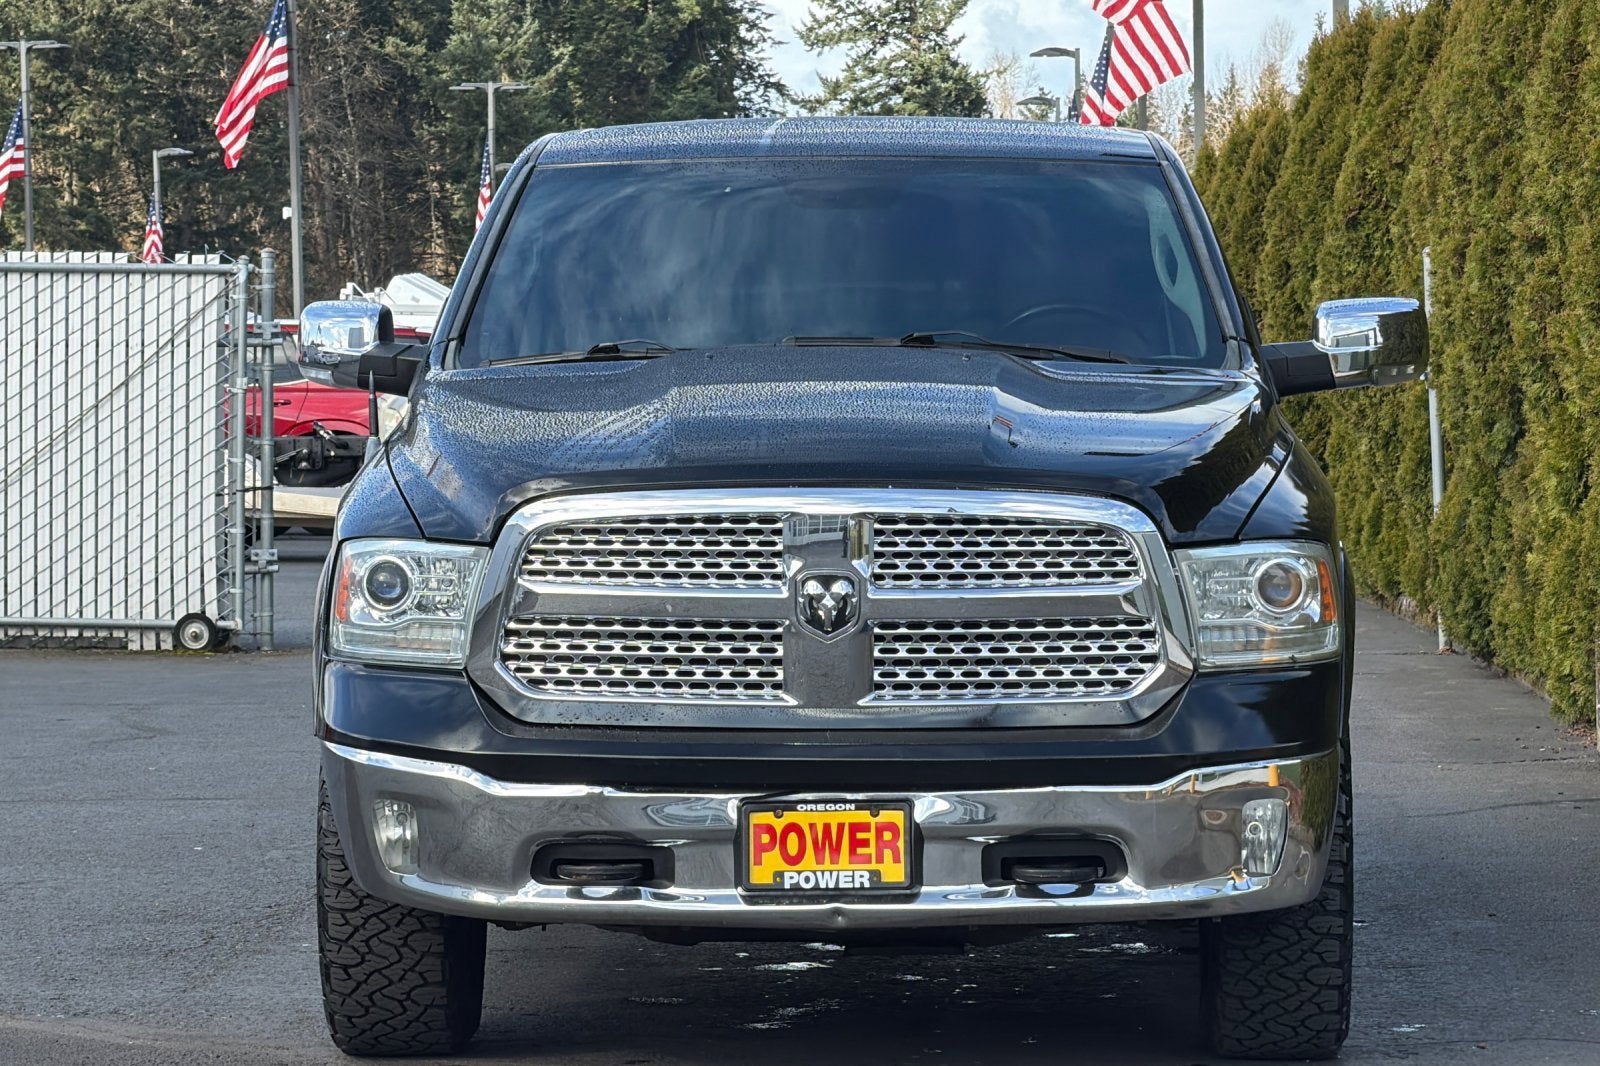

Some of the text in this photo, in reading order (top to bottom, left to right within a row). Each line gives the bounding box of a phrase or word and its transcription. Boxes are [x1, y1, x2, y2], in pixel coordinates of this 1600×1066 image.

[796, 803, 856, 811] OREGON
[753, 822, 902, 866] POWER
[784, 871, 870, 889] POWER
